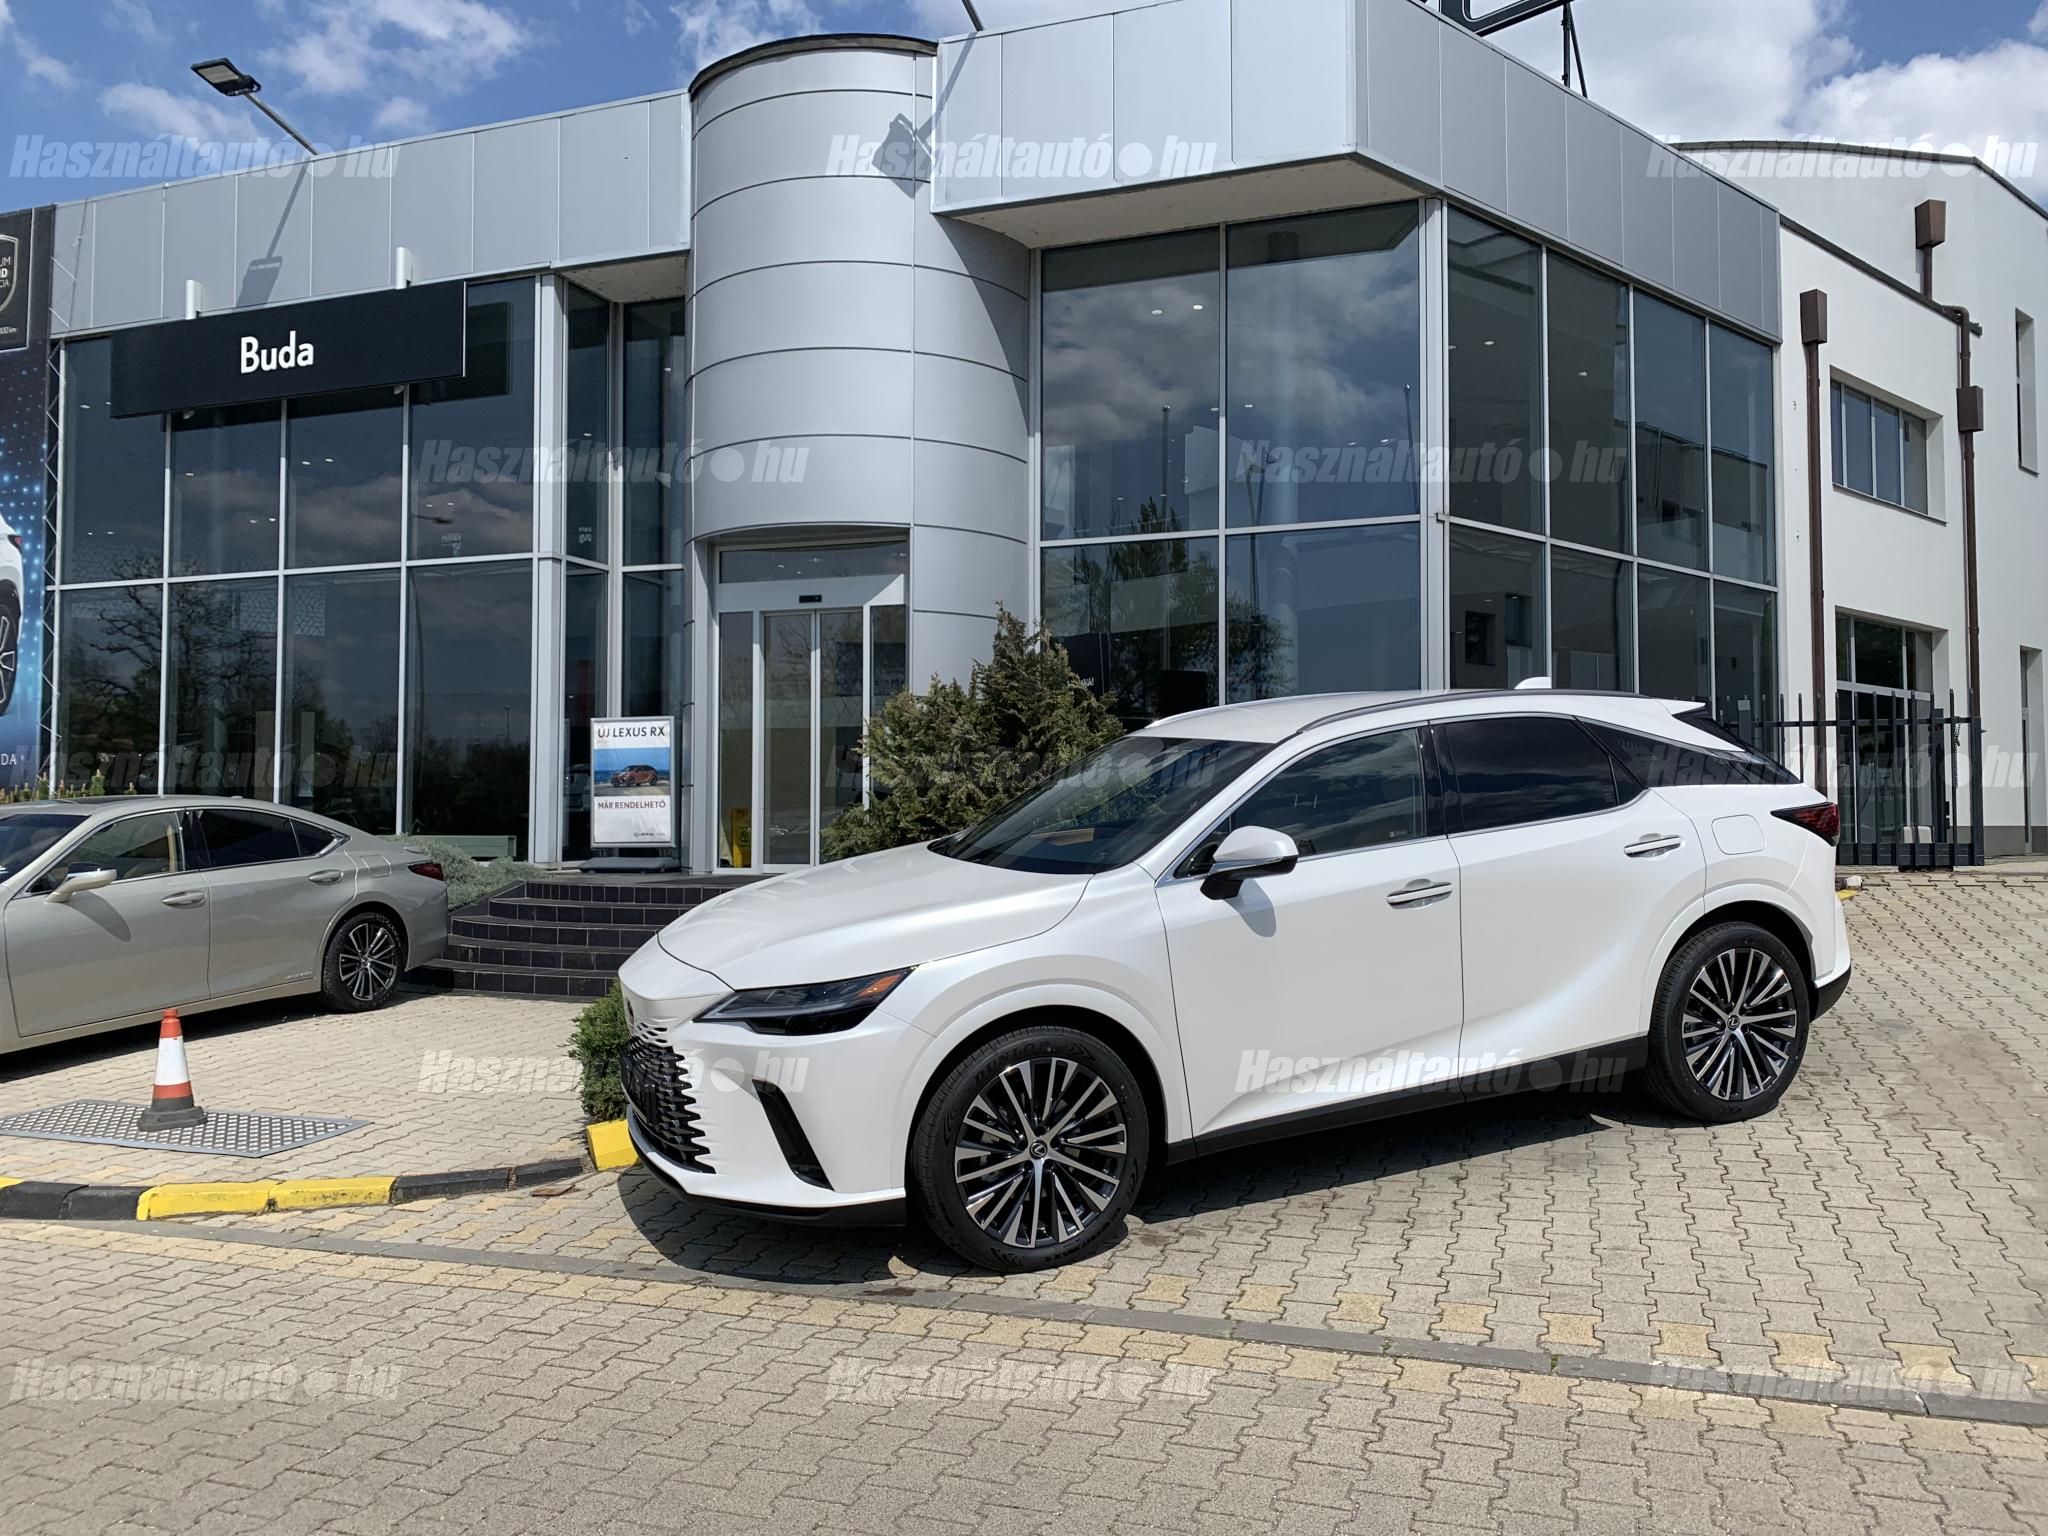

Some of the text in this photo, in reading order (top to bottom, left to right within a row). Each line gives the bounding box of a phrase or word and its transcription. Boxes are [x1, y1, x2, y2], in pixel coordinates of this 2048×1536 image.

[241, 330, 314, 374] Buda
[597, 724, 665, 738] ÚJ LEXUS RX
[598, 800, 613, 809] MÁR
